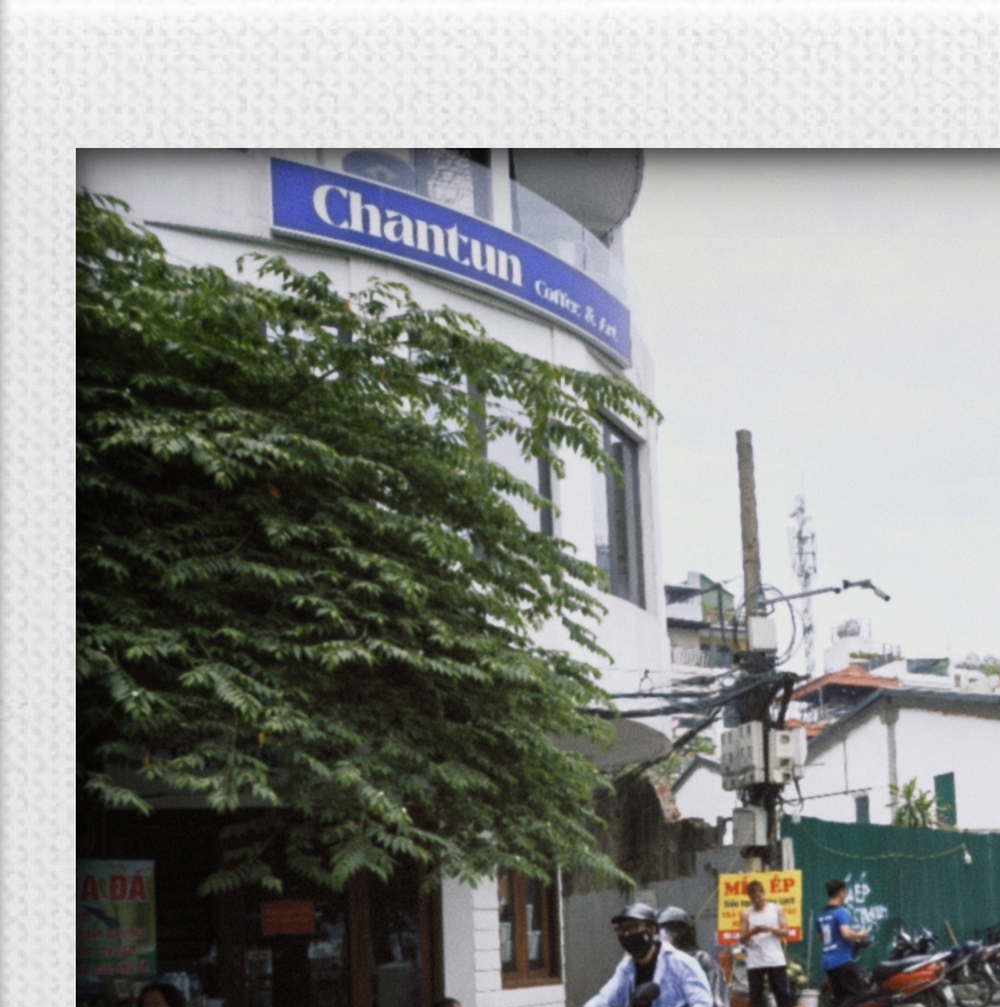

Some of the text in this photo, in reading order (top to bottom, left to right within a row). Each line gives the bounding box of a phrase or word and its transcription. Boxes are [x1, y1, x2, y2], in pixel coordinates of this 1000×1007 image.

[313, 184, 523, 288] Chantun
[535, 279, 581, 318] Coffee
[585, 305, 597, 327] &
[723, 873, 796, 896] MÍ ÉP
